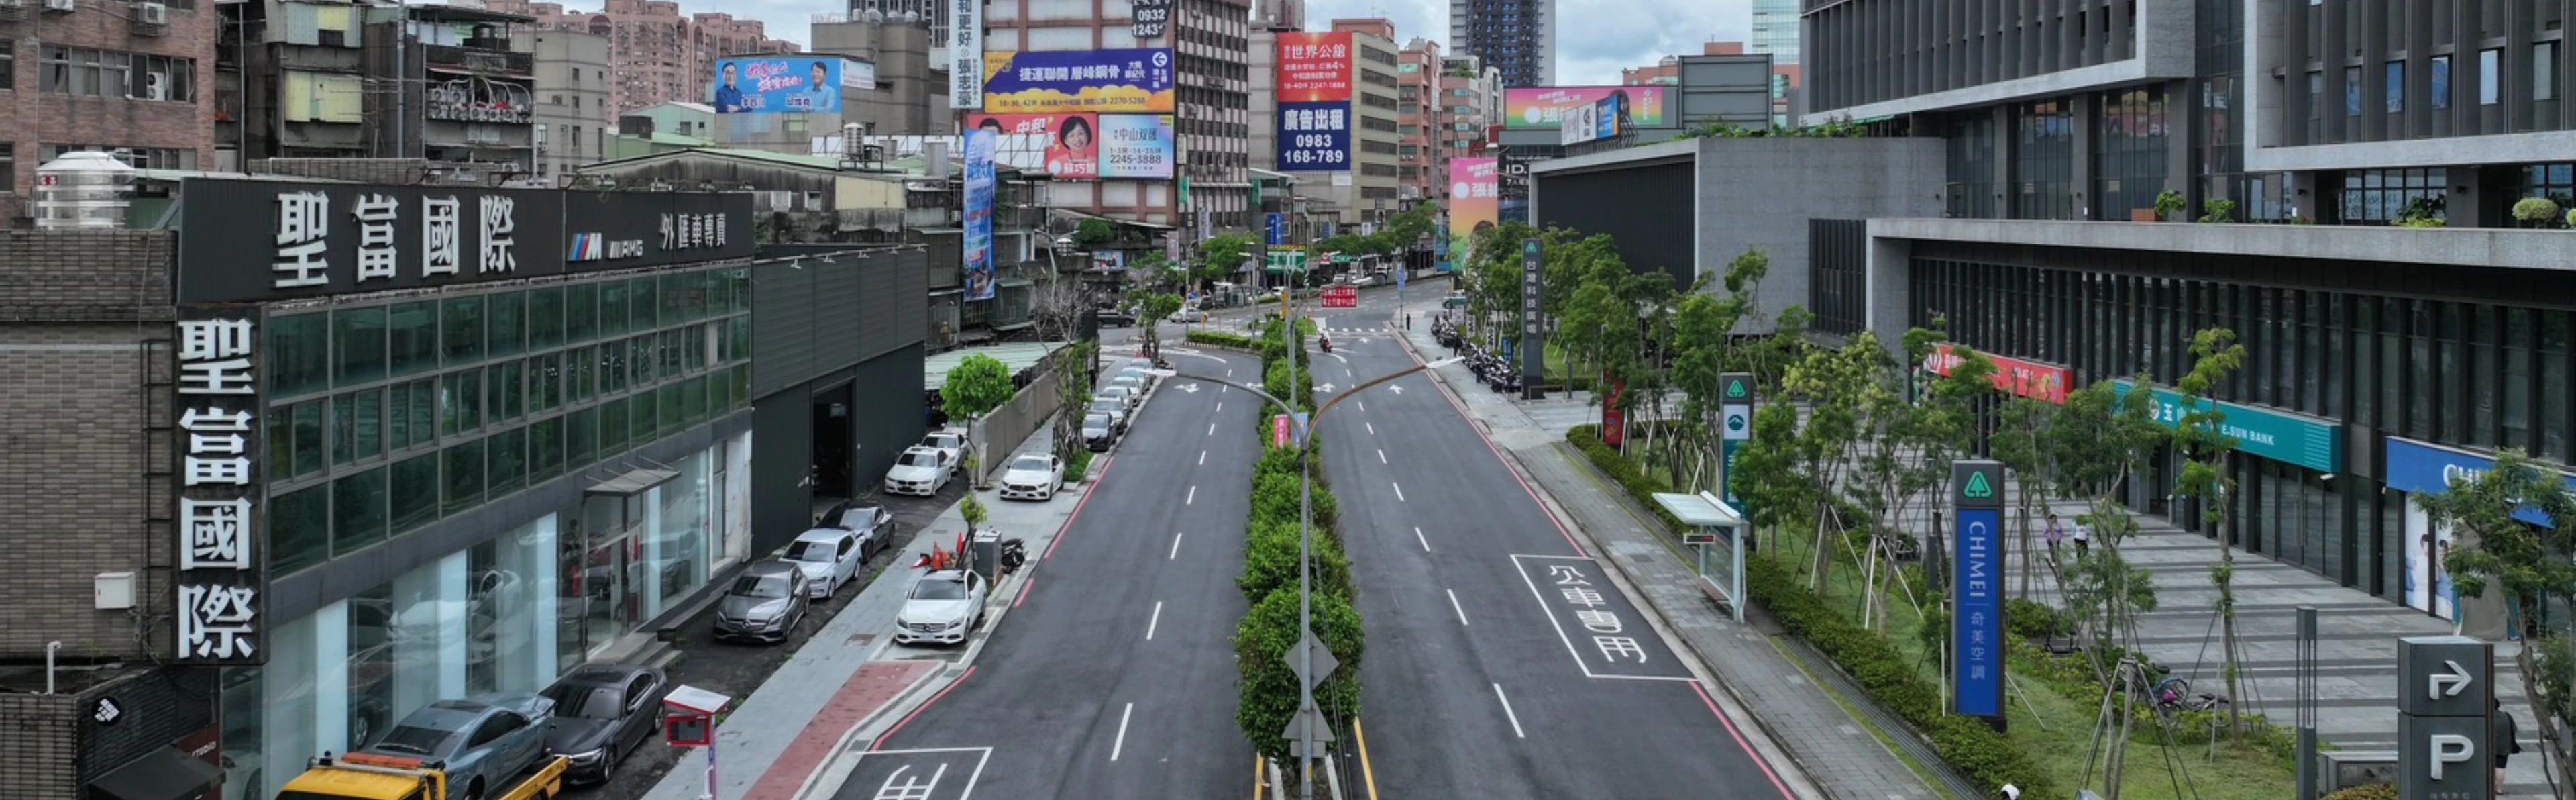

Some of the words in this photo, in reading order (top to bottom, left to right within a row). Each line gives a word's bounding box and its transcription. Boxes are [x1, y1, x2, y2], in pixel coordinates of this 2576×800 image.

[1138, 9, 1165, 21] 0932
[1284, 109, 1344, 130] 廣告出租
[1110, 154, 1162, 164] 2245-3888
[1284, 150, 1344, 163] 168-789
[1296, 135, 1332, 148] 0983
[272, 191, 516, 289] 聖富國際
[659, 213, 726, 250] 外匯車專賣
[1526, 260, 1538, 334] 台灣科技廣場
[2222, 423, 2247, 438] E.SUN
[2249, 432, 2275, 446] BANK
[178, 317, 257, 660] 聖富國際
[1968, 521, 1986, 597] CHIMEI
[1550, 565, 1647, 663] 公車專用
[1970, 611, 1985, 679] 奇美空調
[2430, 735, 2474, 779] P
